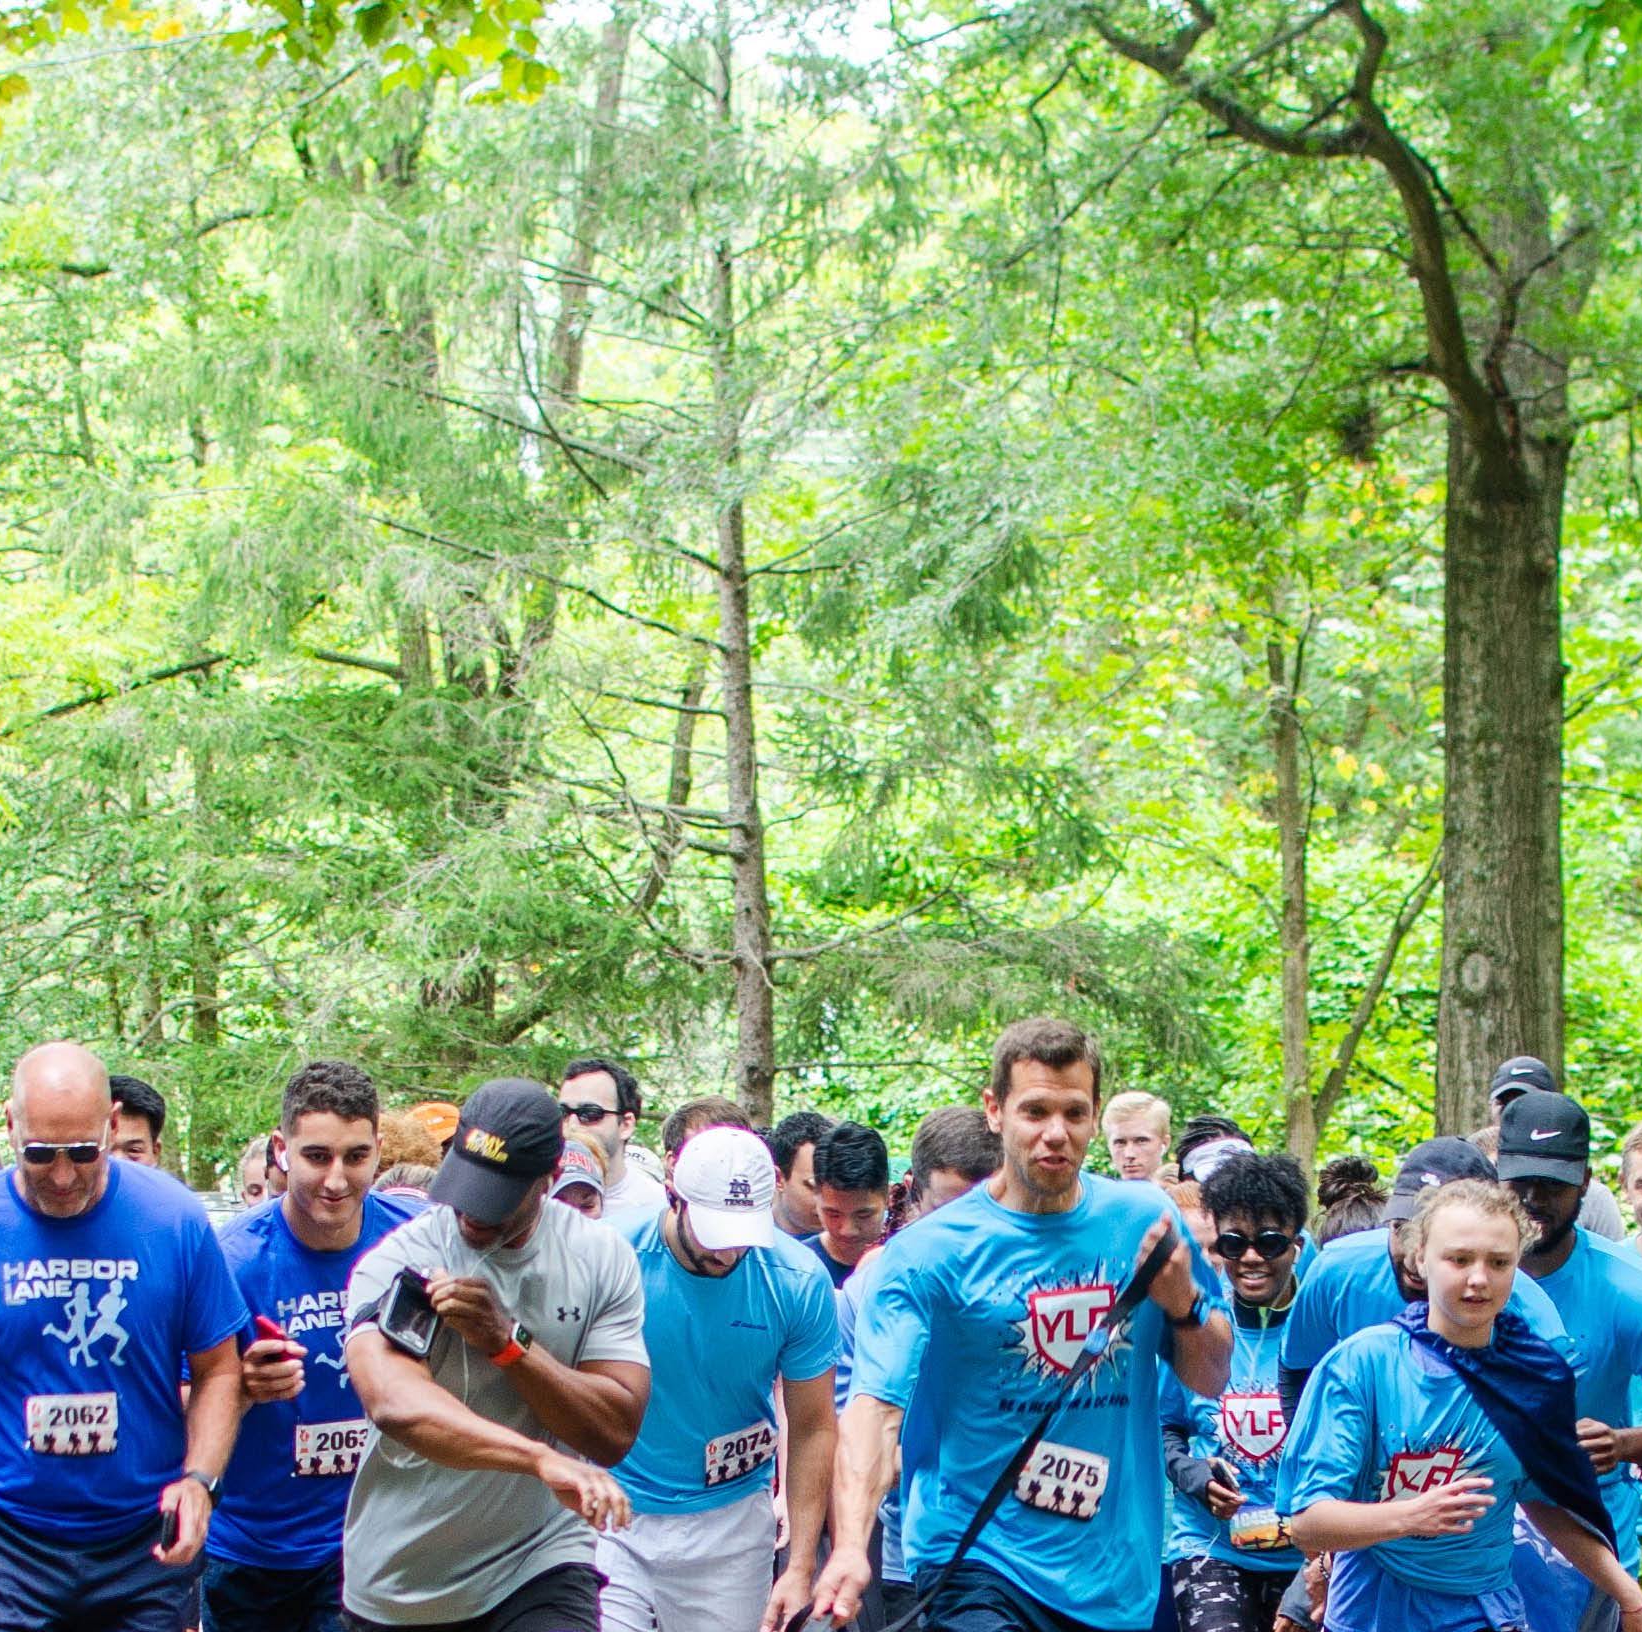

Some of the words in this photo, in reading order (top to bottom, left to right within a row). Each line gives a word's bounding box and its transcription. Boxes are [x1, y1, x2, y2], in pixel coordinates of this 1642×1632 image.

[3, 1258, 140, 1282] HARBOR
[4, 1279, 73, 1307] LANE
[278, 1310, 344, 1339] LANE
[49, 1404, 110, 1428] 2062
[1228, 1409, 1283, 1436] YLF
[723, 1427, 772, 1460] 2074
[1038, 1453, 1100, 1488] 2075
